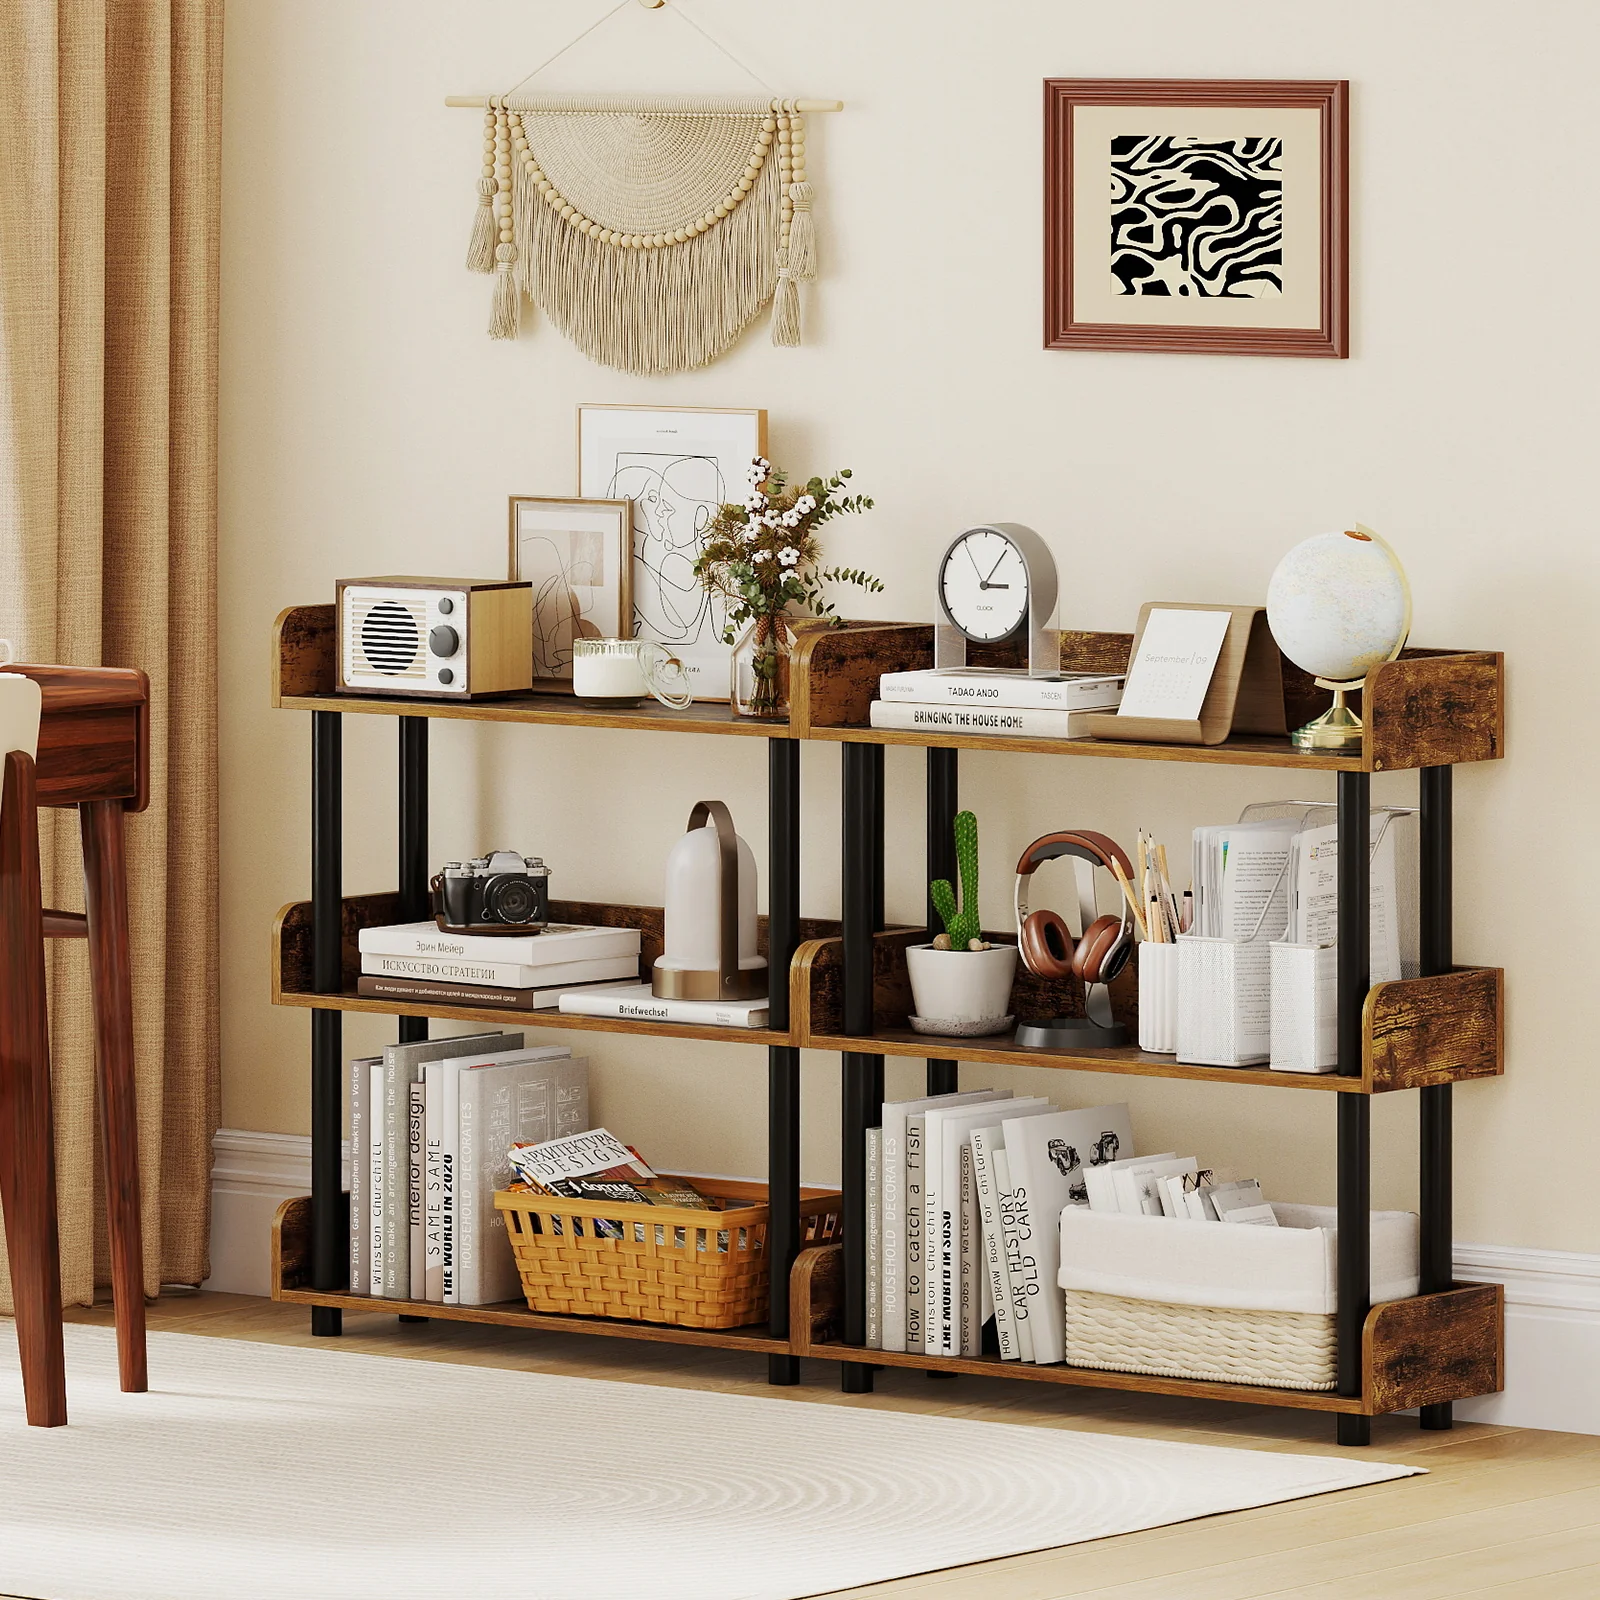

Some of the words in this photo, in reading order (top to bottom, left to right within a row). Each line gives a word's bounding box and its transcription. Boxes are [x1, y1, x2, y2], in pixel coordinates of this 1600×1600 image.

[1144, 653, 1189, 663] September
[947, 687, 975, 698] TADAO
[976, 688, 999, 699] ANDO
[914, 710, 953, 725] BRINGING
[954, 712, 970, 726] THE
[972, 713, 999, 728] HOUSE
[1000, 715, 1023, 728] HOME
[416, 940, 436, 953] Эрин
[437, 942, 464, 955] Мейер
[382, 959, 439, 975] ИСКУССТВО
[441, 965, 495, 980] СТРАТЕГИИ
[618, 1004, 669, 1018] Briefwechsel
[352, 1066, 360, 1096] Voice
[387, 1051, 396, 1083] house
[387, 1088, 396, 1106] the
[352, 1113, 361, 1154] Hawking
[387, 1112, 396, 1125] in
[410, 1091, 425, 1154] design
[461, 1102, 472, 1181] DECORATES
[521, 1132, 618, 1165] АРХИТЕКТУРА
[869, 1134, 877, 1160] house
[907, 1127, 920, 1170] fish
[387, 1131, 397, 1198] arrangement
[428, 1139, 440, 1192] SAME
[443, 1154, 453, 1193] 2020
[537, 1144, 627, 1176] DESIGN
[869, 1165, 877, 1181] the
[974, 1134, 988, 1195] children
[352, 1160, 361, 1200] Stephen
[372, 1141, 382, 1217] Churchill
[580, 1180, 635, 1192] domus
[885, 1138, 897, 1220] DECORATES
[909, 1184, 920, 1194] a
[961, 1148, 969, 1204] Isaacson
[410, 1160, 421, 1226] Interior
[443, 1196, 453, 1211] IN
[869, 1186, 877, 1198] in
[352, 1206, 360, 1230] Gave
[388, 1203, 396, 1216] an
[984, 1204, 993, 1224] for
[1012, 1187, 1032, 1241] CARS
[387, 1221, 396, 1247] make
[428, 1203, 440, 1256] SAME
[443, 1214, 453, 1267] WORLD
[461, 1190, 472, 1269] HOUSEHOLD
[869, 1203, 878, 1261] arrangement
[908, 1206, 920, 1262] catch
[926, 1192, 936, 1271] Churchill
[961, 1211, 969, 1254] Walter
[999, 1191, 1023, 1273] HISTORY
[352, 1235, 360, 1265] Intel
[372, 1225, 382, 1285] Winston
[387, 1252, 396, 1263] to
[352, 1270, 360, 1289] How
[387, 1269, 395, 1289] How
[869, 1265, 877, 1277] an
[885, 1230, 897, 1313] HOUSEHOLD
[962, 1260, 971, 1275] by
[1022, 1255, 1040, 1296] OLD
[443, 1270, 453, 1297] THE
[869, 1281, 877, 1303] make
[908, 1275, 920, 1296] to
[961, 1282, 969, 1309] Jobs
[991, 1270, 1004, 1301] DRAW
[869, 1307, 877, 1318] to
[926, 1281, 936, 1344] Winston
[997, 1308, 1006, 1324] TO
[1012, 1285, 1029, 1321] CAR
[869, 1324, 877, 1340] How
[908, 1308, 920, 1342] How
[961, 1316, 969, 1352] Steve
[1000, 1331, 1011, 1354] HOW
